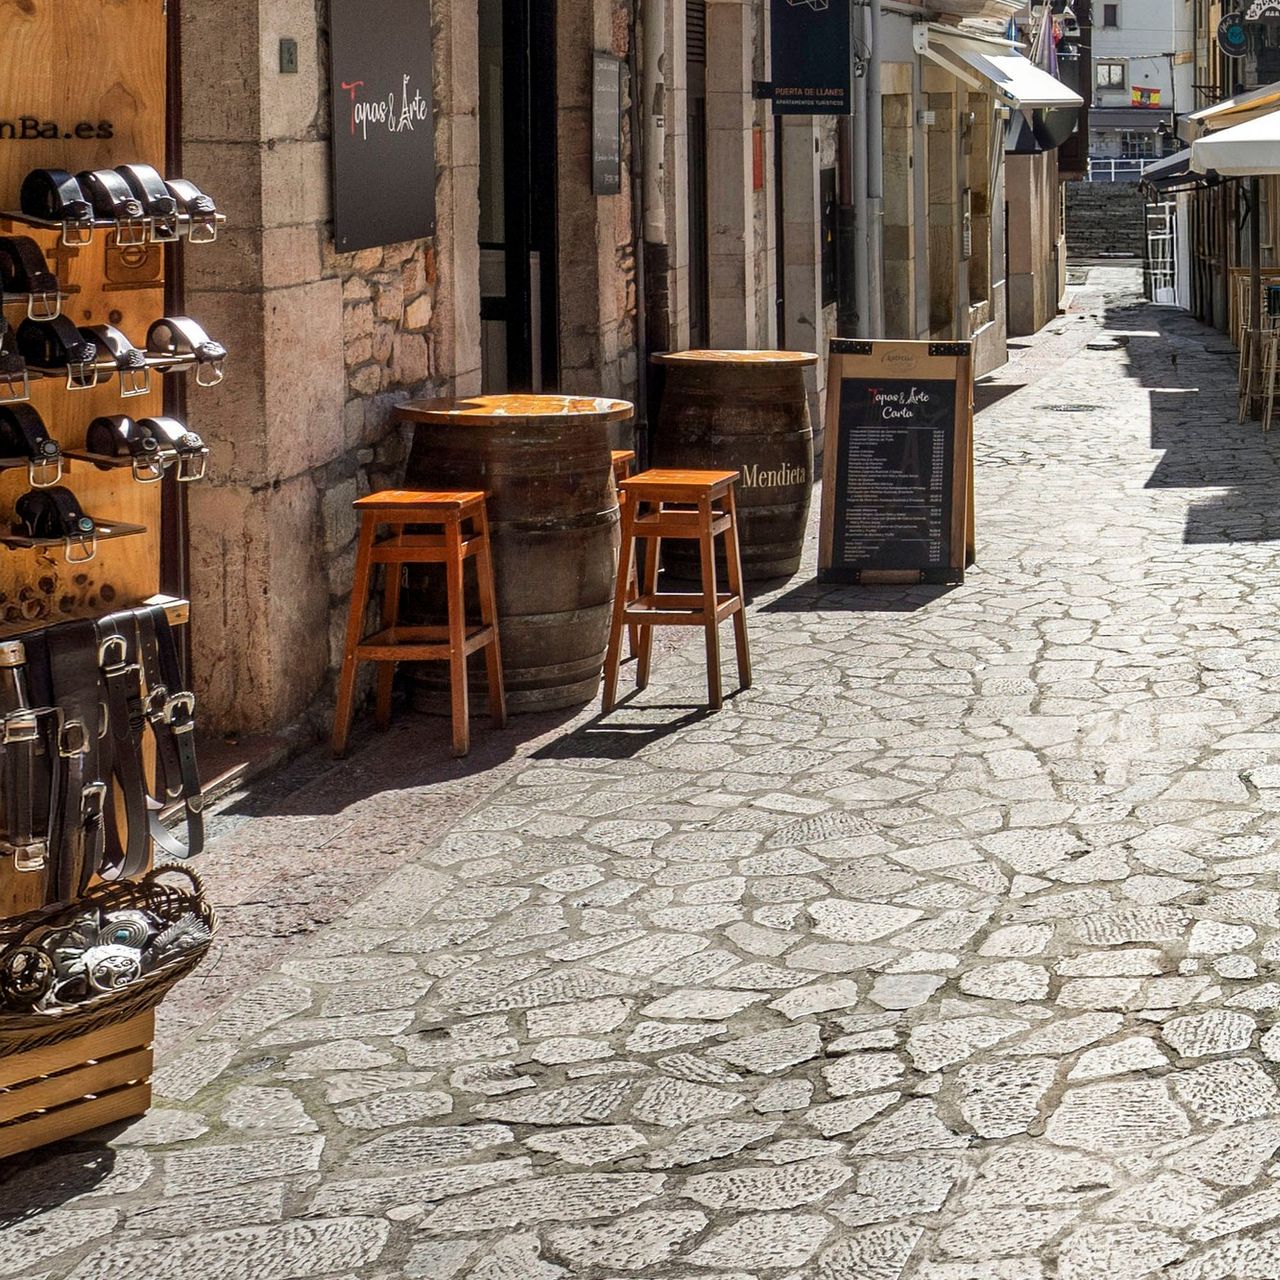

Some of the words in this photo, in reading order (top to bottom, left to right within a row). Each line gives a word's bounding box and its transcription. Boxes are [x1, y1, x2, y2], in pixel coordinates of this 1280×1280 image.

[775, 87, 803, 96] PUERTA
[804, 87, 815, 96] DE
[816, 87, 845, 96] LLANES
[341, 80, 388, 141] Tapas
[387, 92, 397, 133] &
[396, 73, 428, 134] Arte
[867, 386, 899, 406] Tapas
[899, 391, 906, 405] &
[905, 387, 930, 405] Arte
[881, 406, 914, 419] Carta
[741, 462, 806, 488] Mendieta
